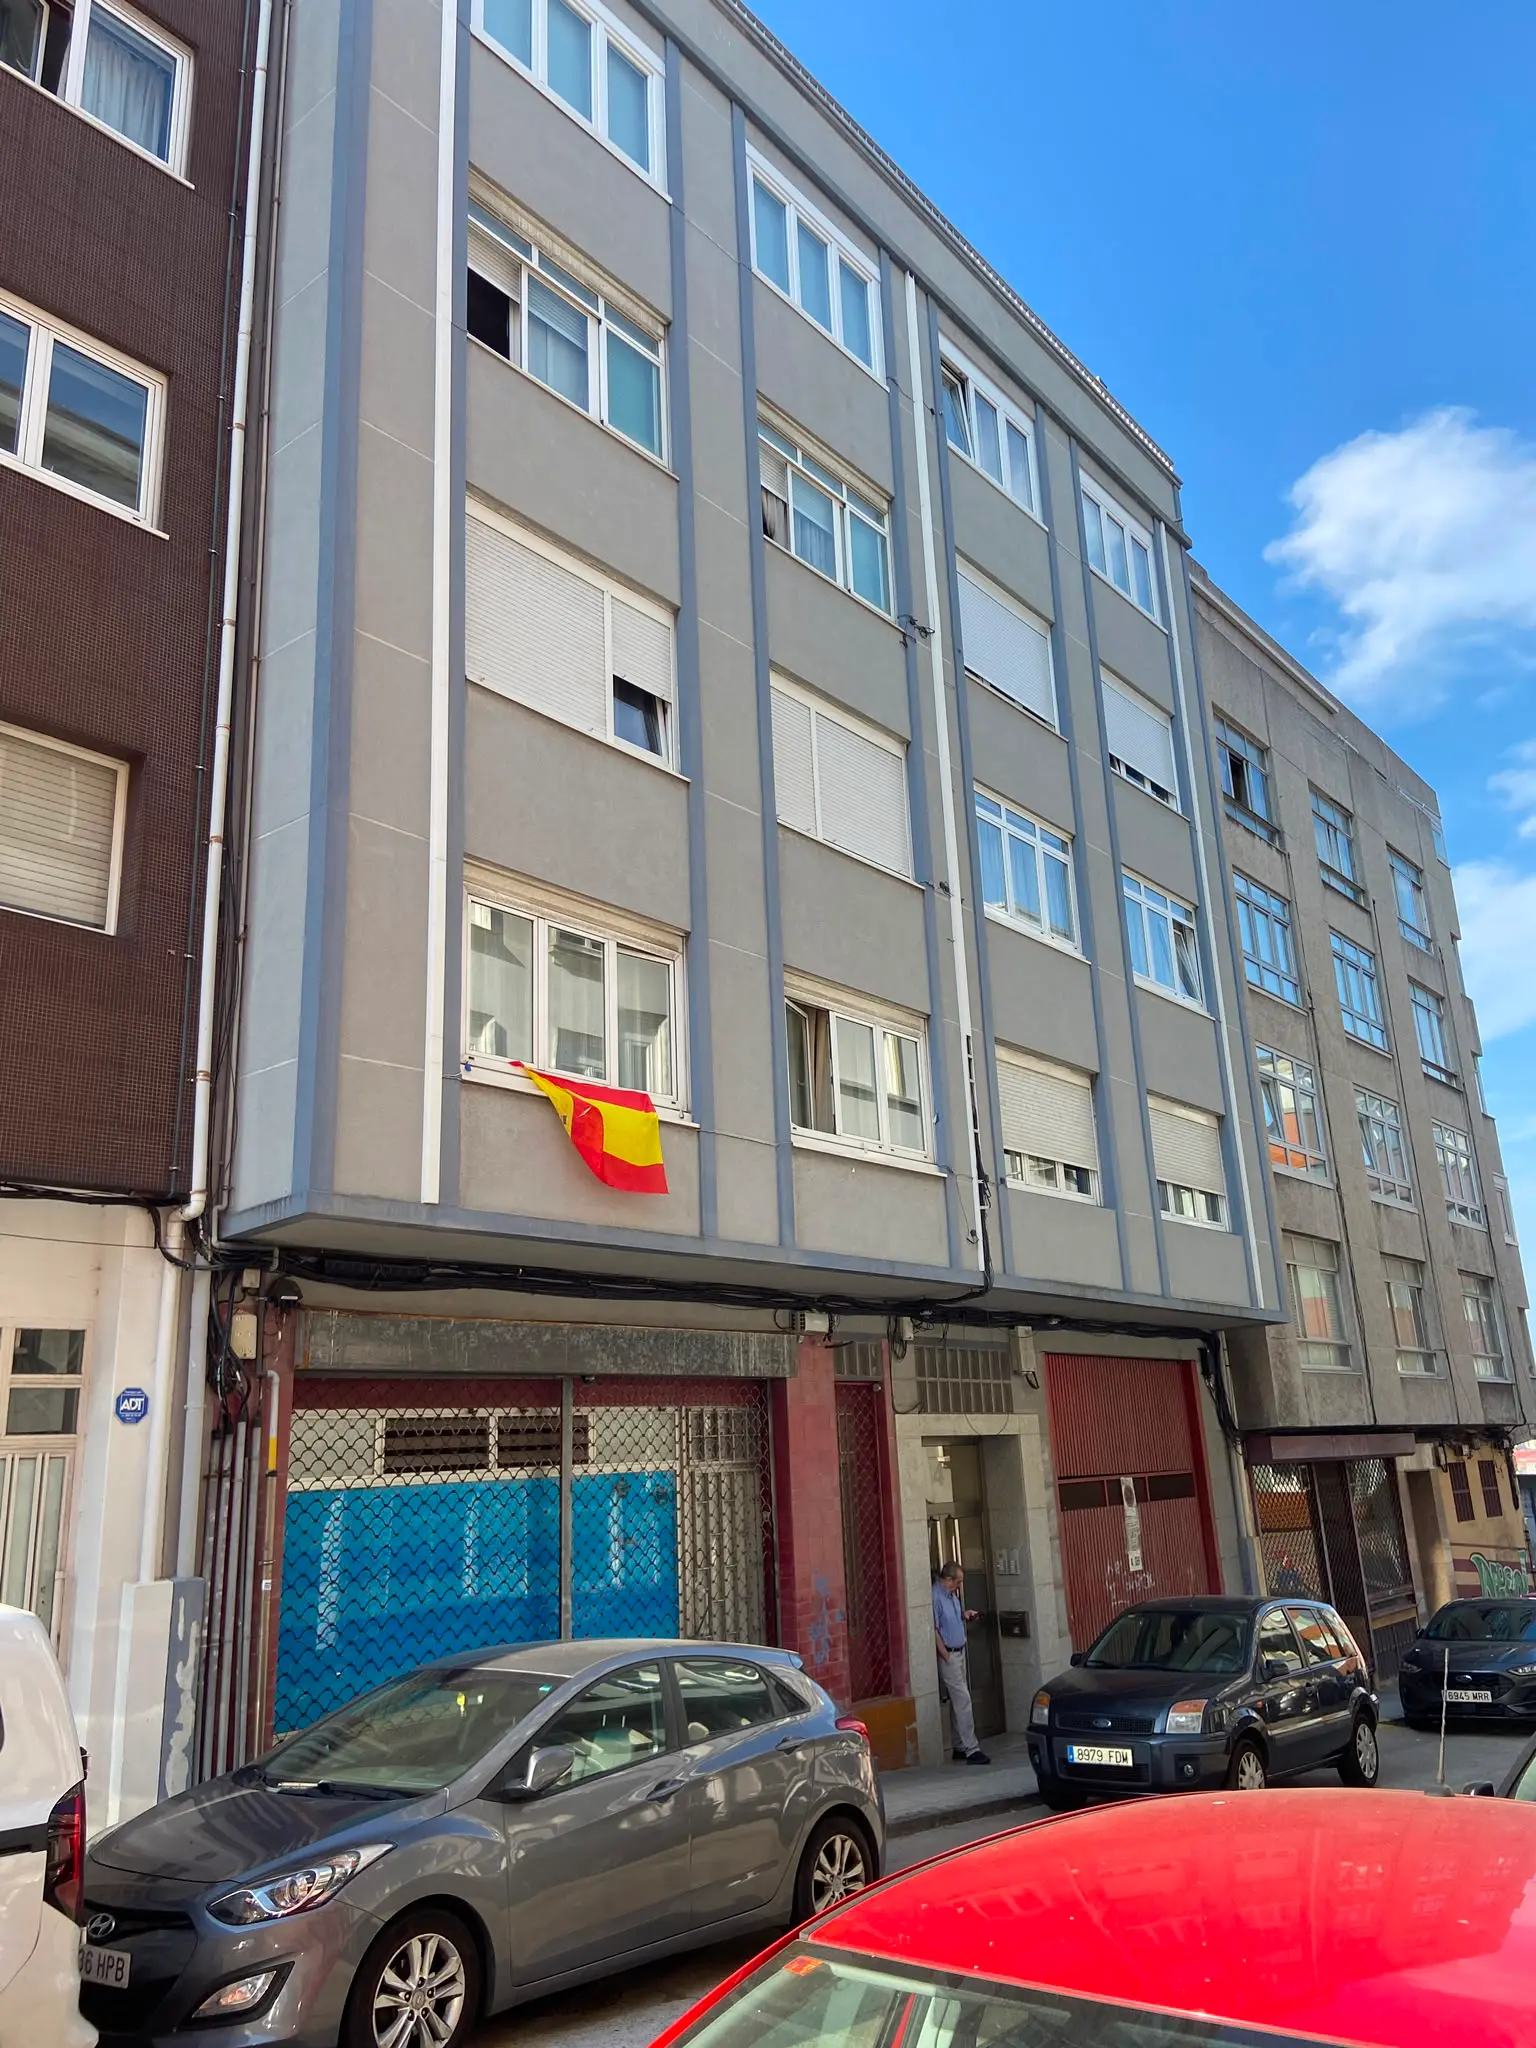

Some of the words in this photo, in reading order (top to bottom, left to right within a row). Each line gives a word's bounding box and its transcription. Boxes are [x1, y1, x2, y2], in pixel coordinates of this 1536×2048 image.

[120, 1398, 144, 1411] ADT
[1447, 1691, 1470, 1701] 6945
[1472, 1692, 1490, 1701] MRR
[1077, 1748, 1103, 1762] 8979
[1108, 1750, 1129, 1764] FDM
[96, 1952, 125, 1982] HPB
